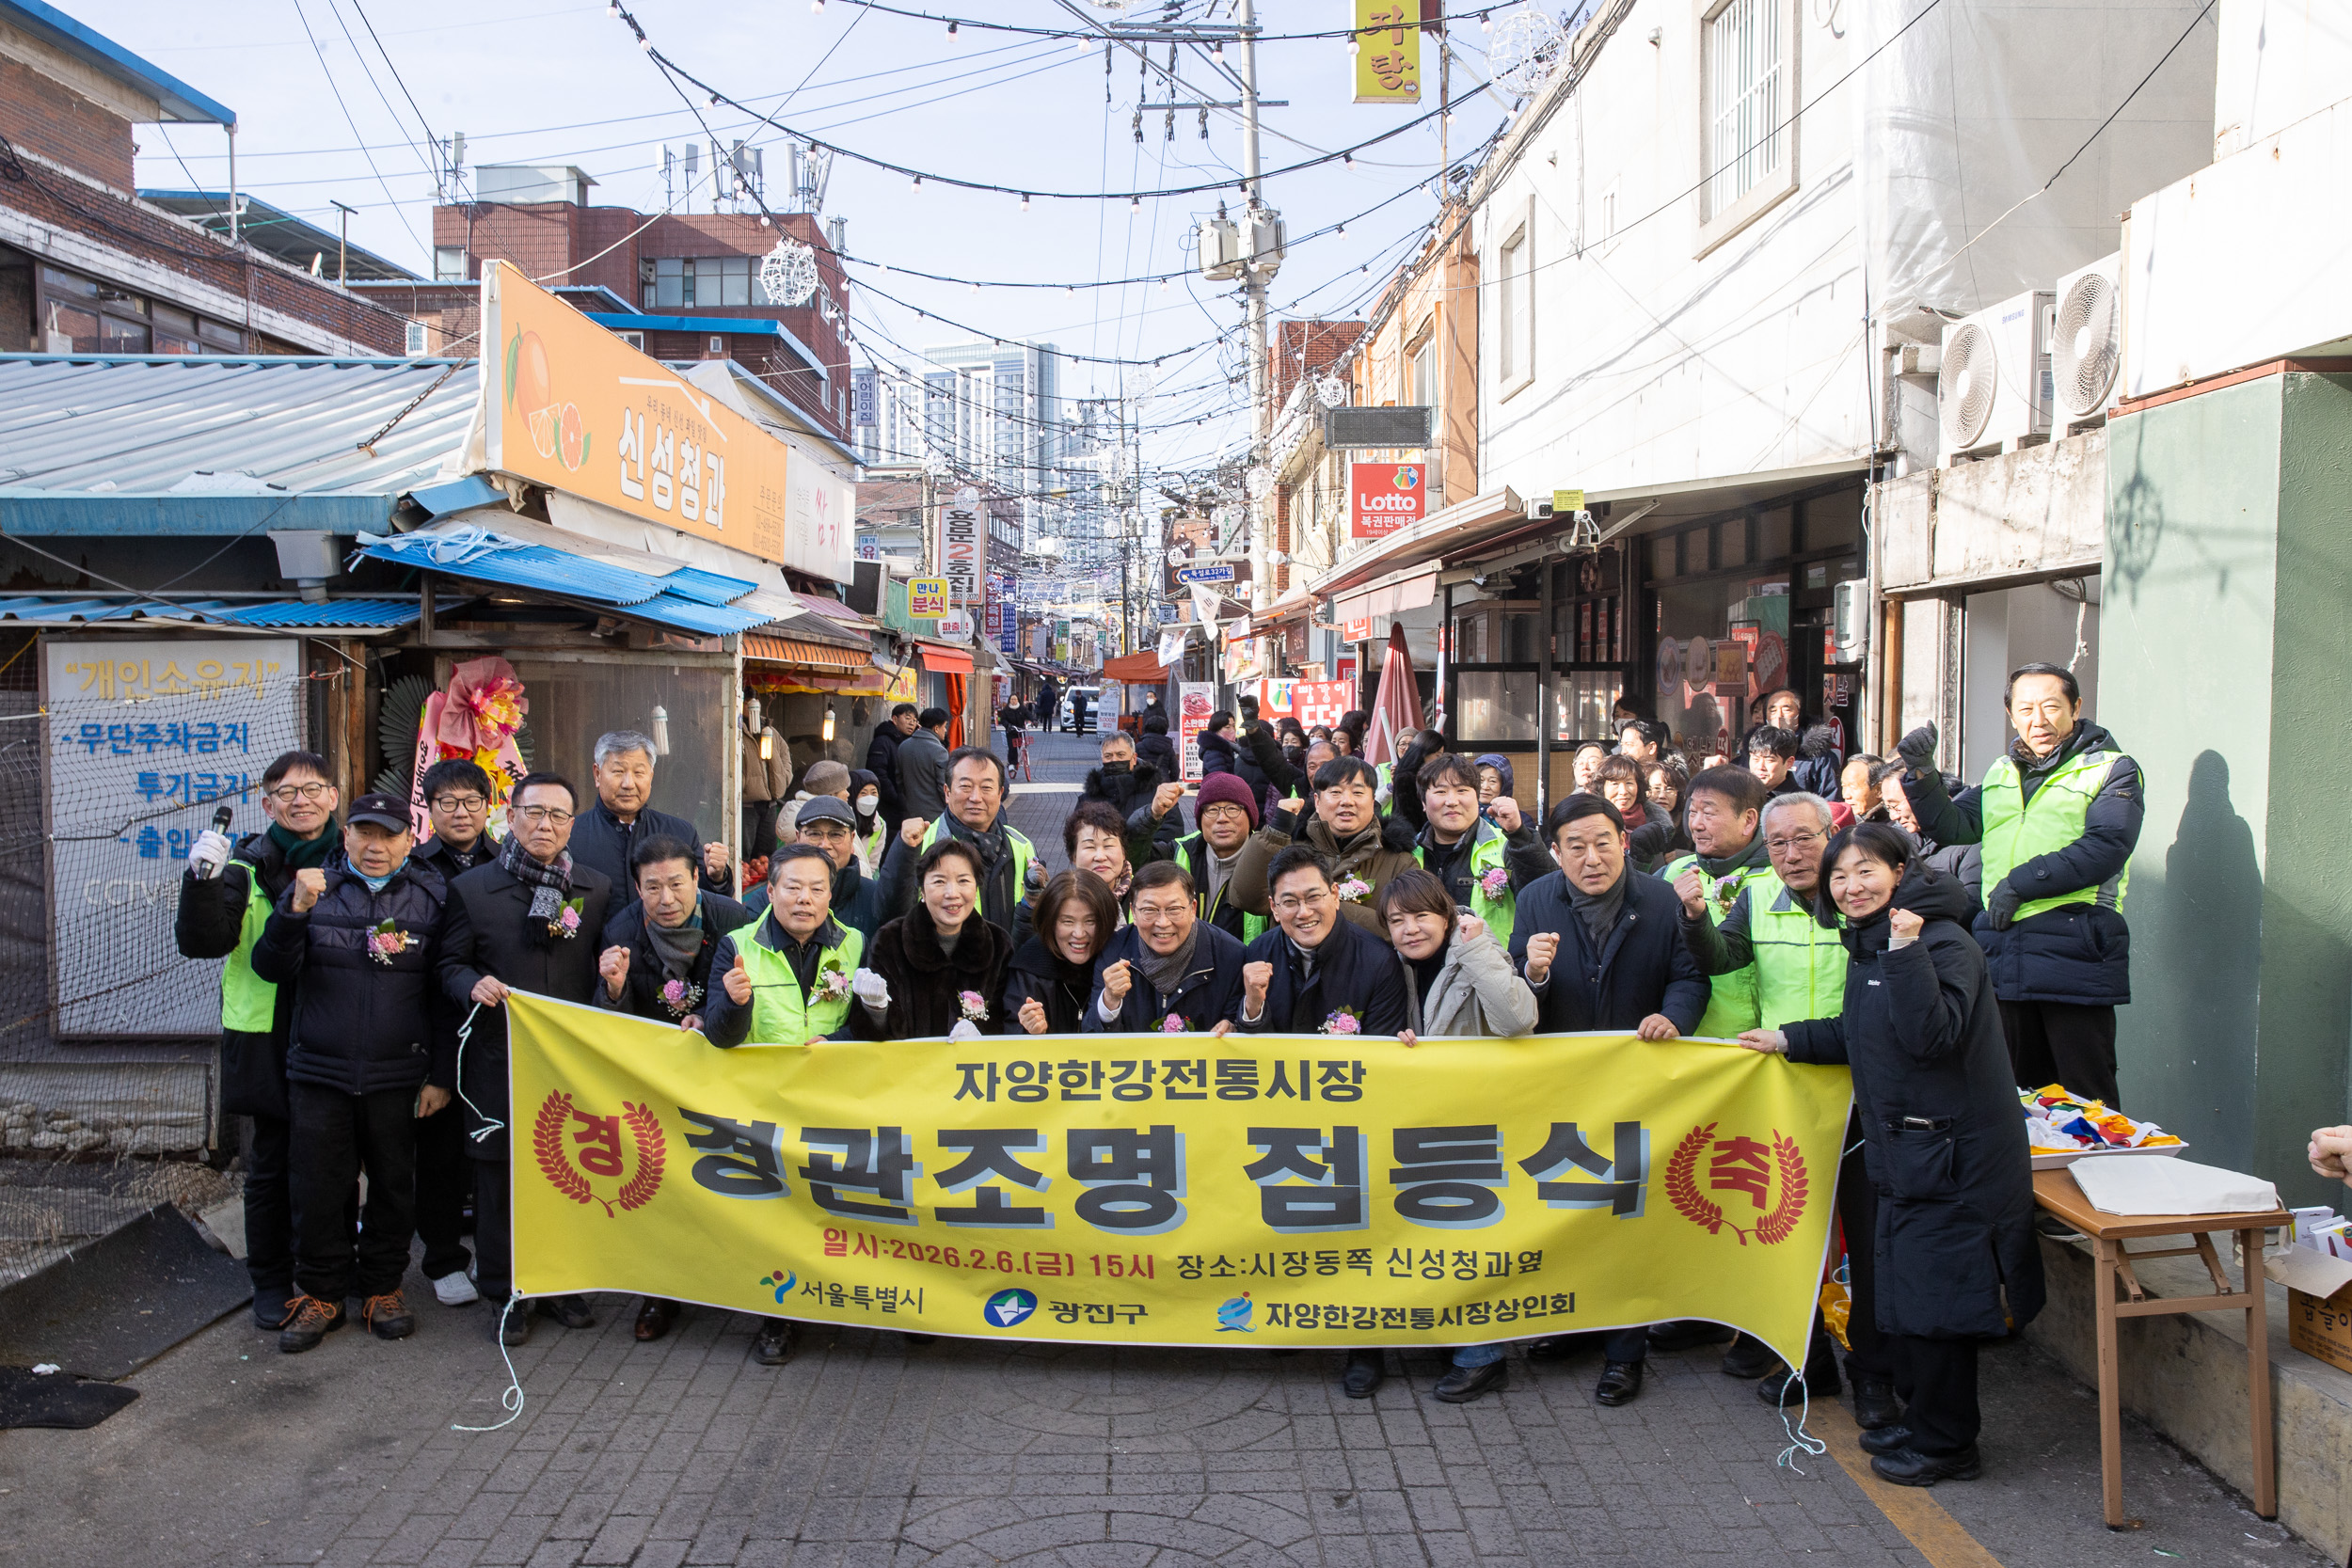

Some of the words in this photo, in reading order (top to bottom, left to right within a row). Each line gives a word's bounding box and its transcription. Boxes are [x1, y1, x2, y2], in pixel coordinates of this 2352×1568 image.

[2001, 309, 2025, 325] SAMSUNG
[860, 383, 872, 420] 어린이집
[618, 406, 725, 531] 신성청과
[1360, 493, 1417, 511] Lotto
[946, 510, 976, 593] 용문2호집
[916, 583, 939, 594] 만나
[1190, 566, 1232, 578] 뚝섬로32가길
[912, 596, 944, 613] 분식
[1823, 675, 1848, 706] 옛날
[135, 772, 247, 804] 투기금지
[953, 1058, 1367, 1103] 자양한강전통시장
[571, 1109, 624, 1178] 경
[677, 1106, 1187, 1236] 경관조명
[1243, 1119, 1650, 1235] 점등식
[1709, 1135, 1771, 1211] 축
[1089, 1254, 1155, 1279] 15시
[1177, 1248, 1374, 1280] 장소:시장동쪽
[1386, 1247, 1543, 1281] 신성청과옆
[801, 1281, 924, 1314] 서울특별시
[1048, 1300, 1149, 1325] 광진구
[1265, 1292, 1576, 1331] 자양한강전통시장상인회
